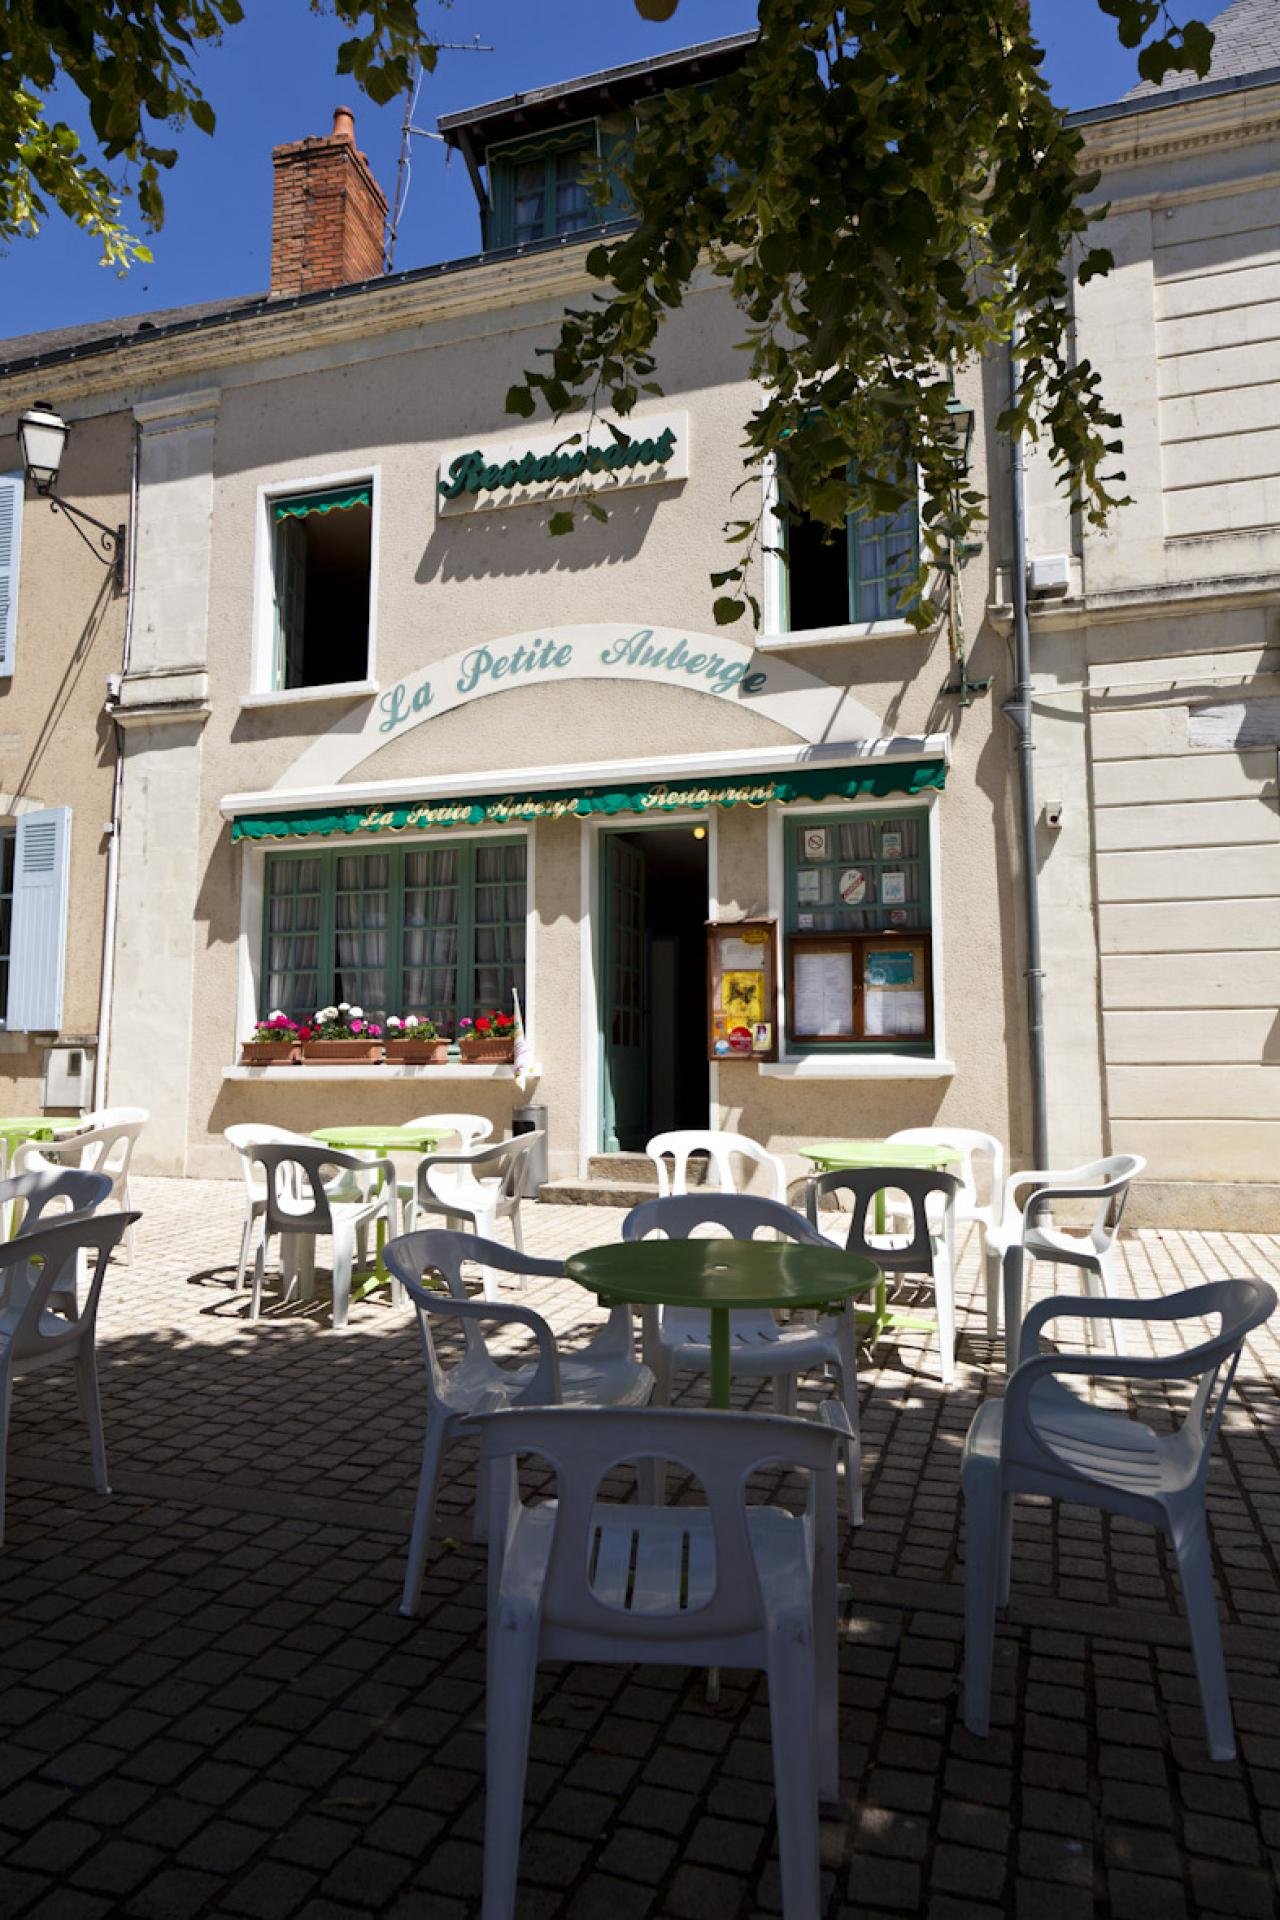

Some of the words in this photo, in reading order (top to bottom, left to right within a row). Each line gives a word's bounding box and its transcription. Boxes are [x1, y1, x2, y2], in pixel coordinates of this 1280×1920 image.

[378, 681, 434, 733] La
[456, 637, 574, 694] Petite
[600, 629, 767, 695] Auberge
